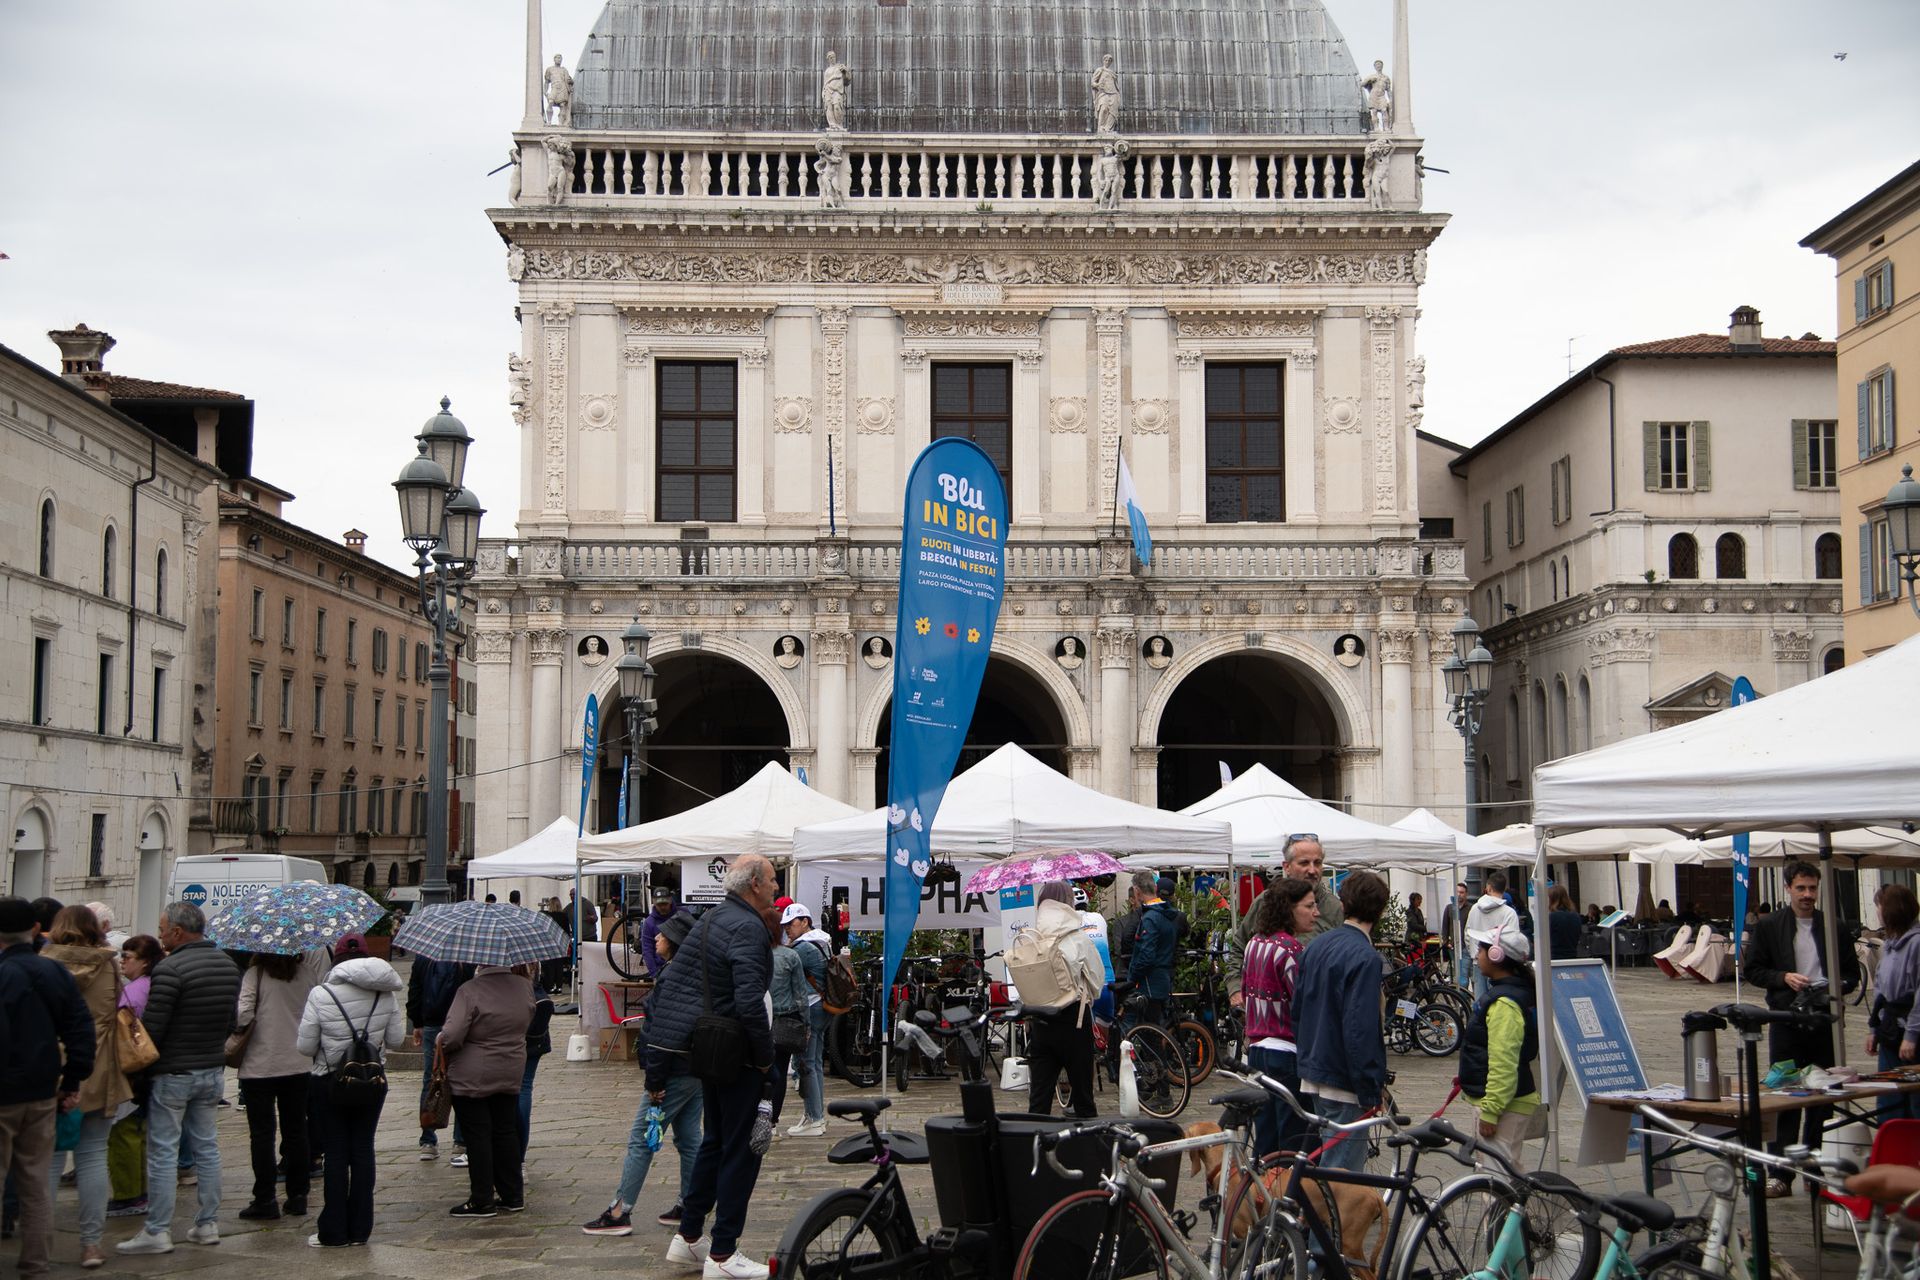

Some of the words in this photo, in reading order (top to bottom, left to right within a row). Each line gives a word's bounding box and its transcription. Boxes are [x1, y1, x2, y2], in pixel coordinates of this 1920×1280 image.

[938, 473, 985, 510] Blu
[924, 500, 948, 527] IN
[956, 508, 997, 540] BICI
[921, 537, 952, 552] RUOTE
[953, 544, 962, 555] IN
[962, 547, 998, 565] LIBERTÀ:
[920, 551, 958, 568] BRESCIA
[960, 560, 968, 571] IN
[969, 562, 996, 578] FESTA!
[918, 570, 939, 578] PIAZZA
[960, 578, 974, 587] PIAZZA
[918, 579, 940, 588] LARGO
[183, 892, 206, 900] STAR
[212, 884, 268, 898] NOLEG
[861, 877, 989, 916] HPHA
[1577, 1042, 1608, 1052] ASSISTENZA
[1608, 1040, 1620, 1050] PER
[1578, 1055, 1586, 1064] LA
[1586, 1052, 1622, 1064] RIPARAZIONE
[1621, 1052, 1626, 1060] E
[1618, 1064, 1628, 1072] PER
[1586, 1080, 1594, 1088] LA
[1594, 1076, 1636, 1088] MANUTENZIONE
